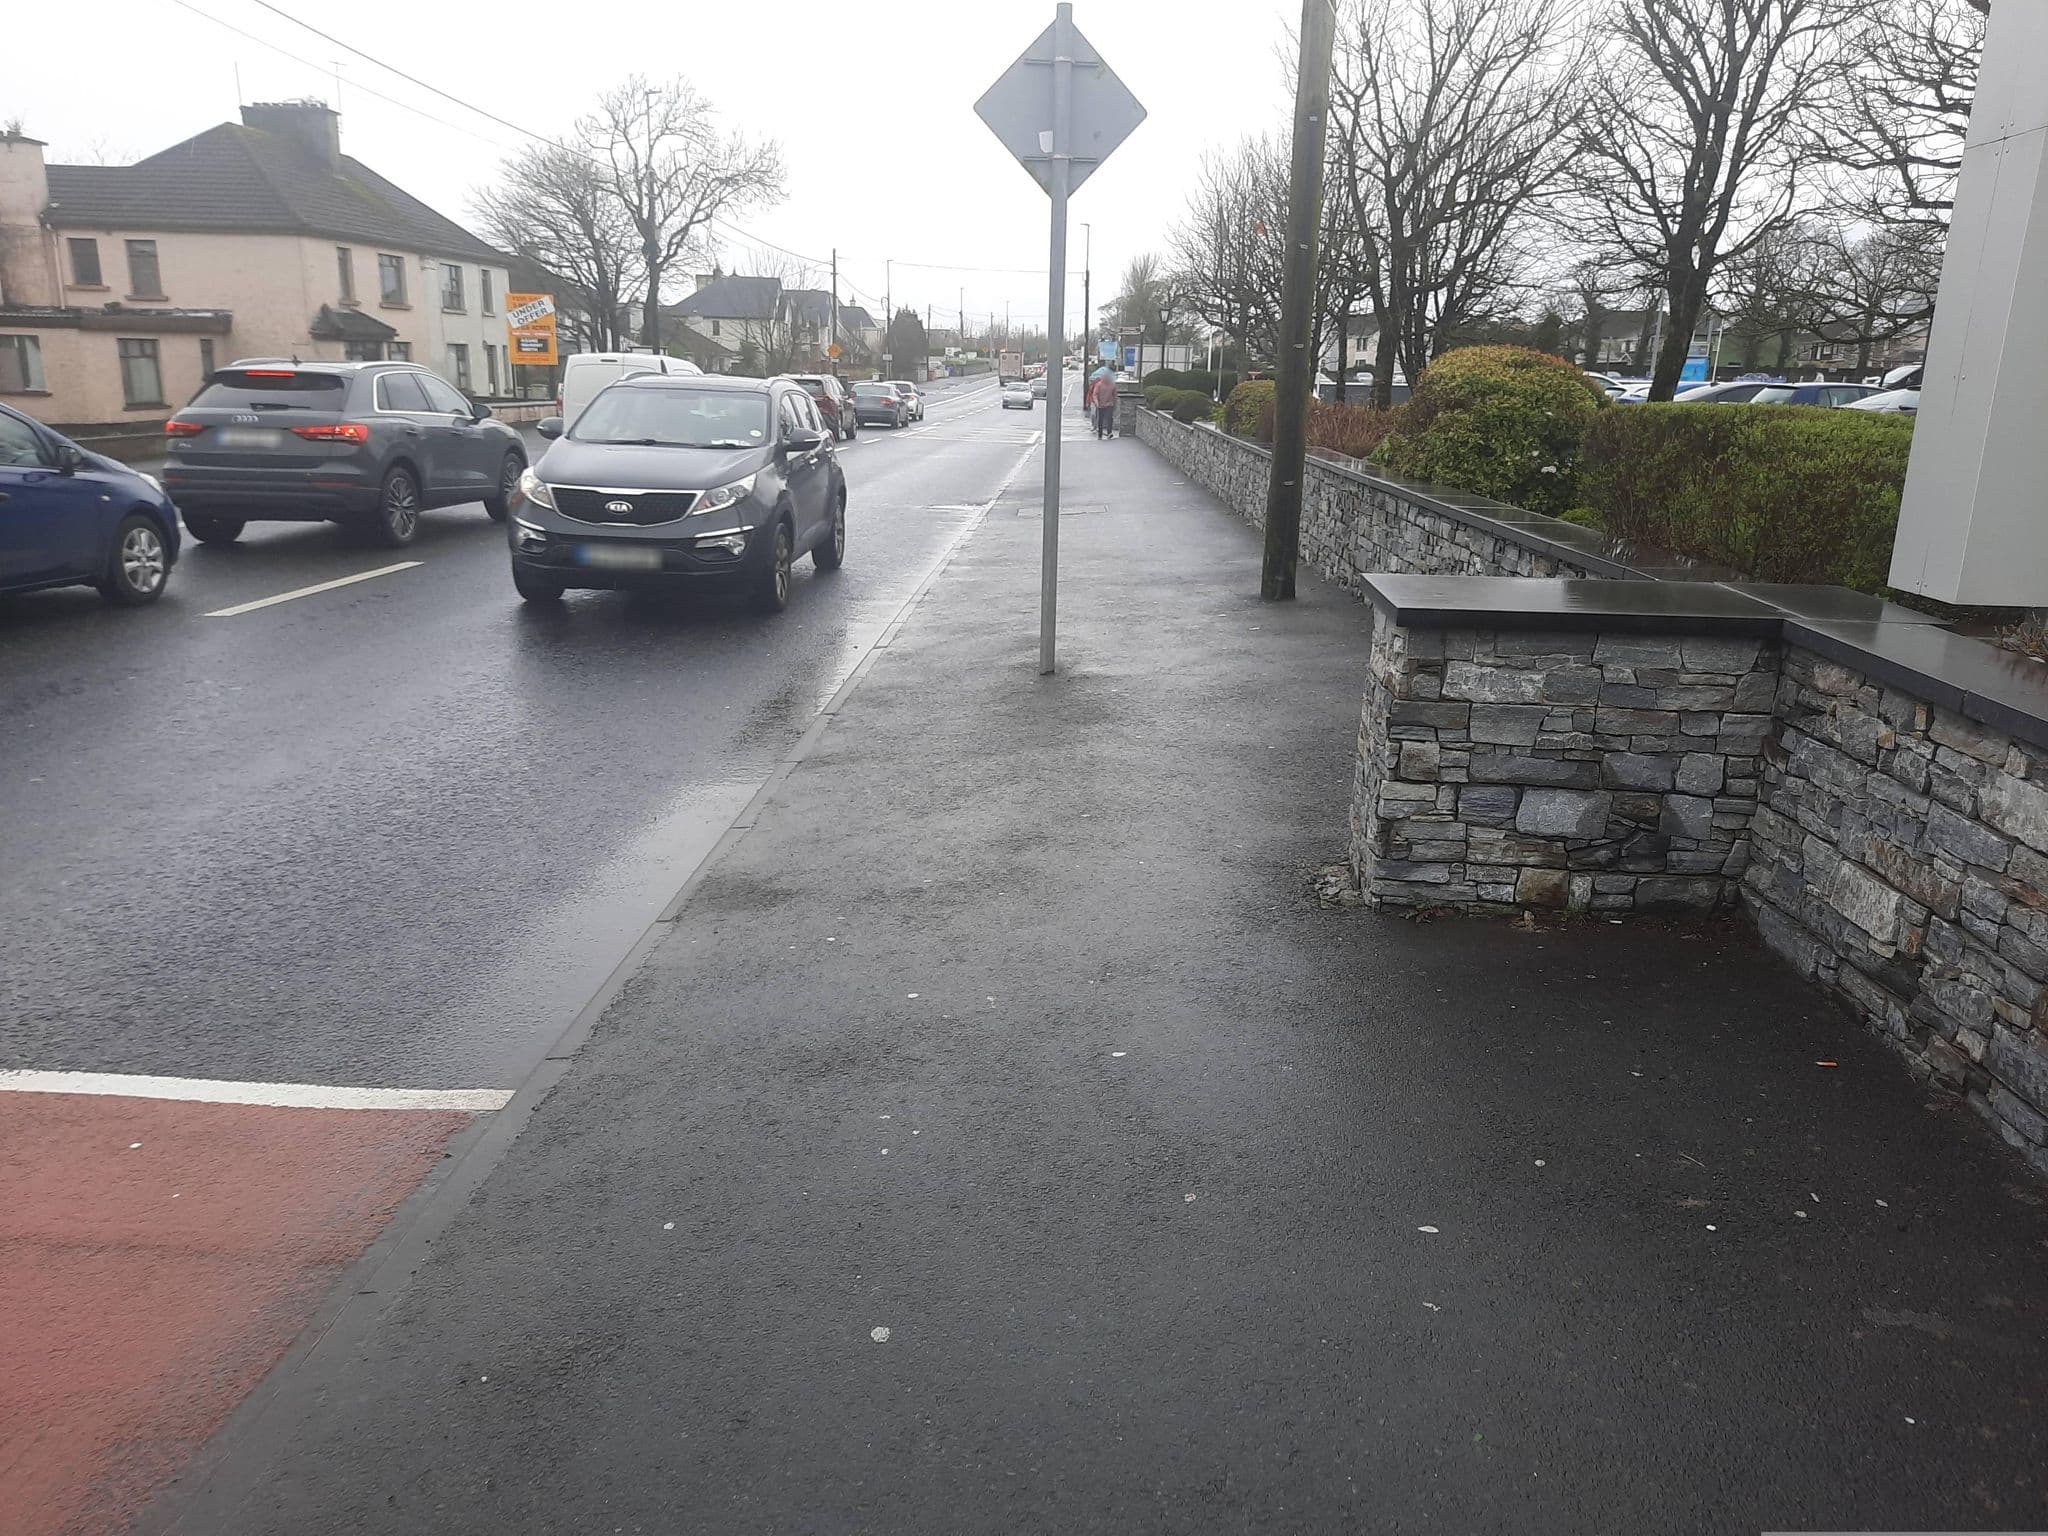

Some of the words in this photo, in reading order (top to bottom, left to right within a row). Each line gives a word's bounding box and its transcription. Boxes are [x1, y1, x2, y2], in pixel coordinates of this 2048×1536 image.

[512, 300, 545, 318] UNDER
[517, 307, 548, 325] OFFER
[609, 503, 629, 512] KIA
